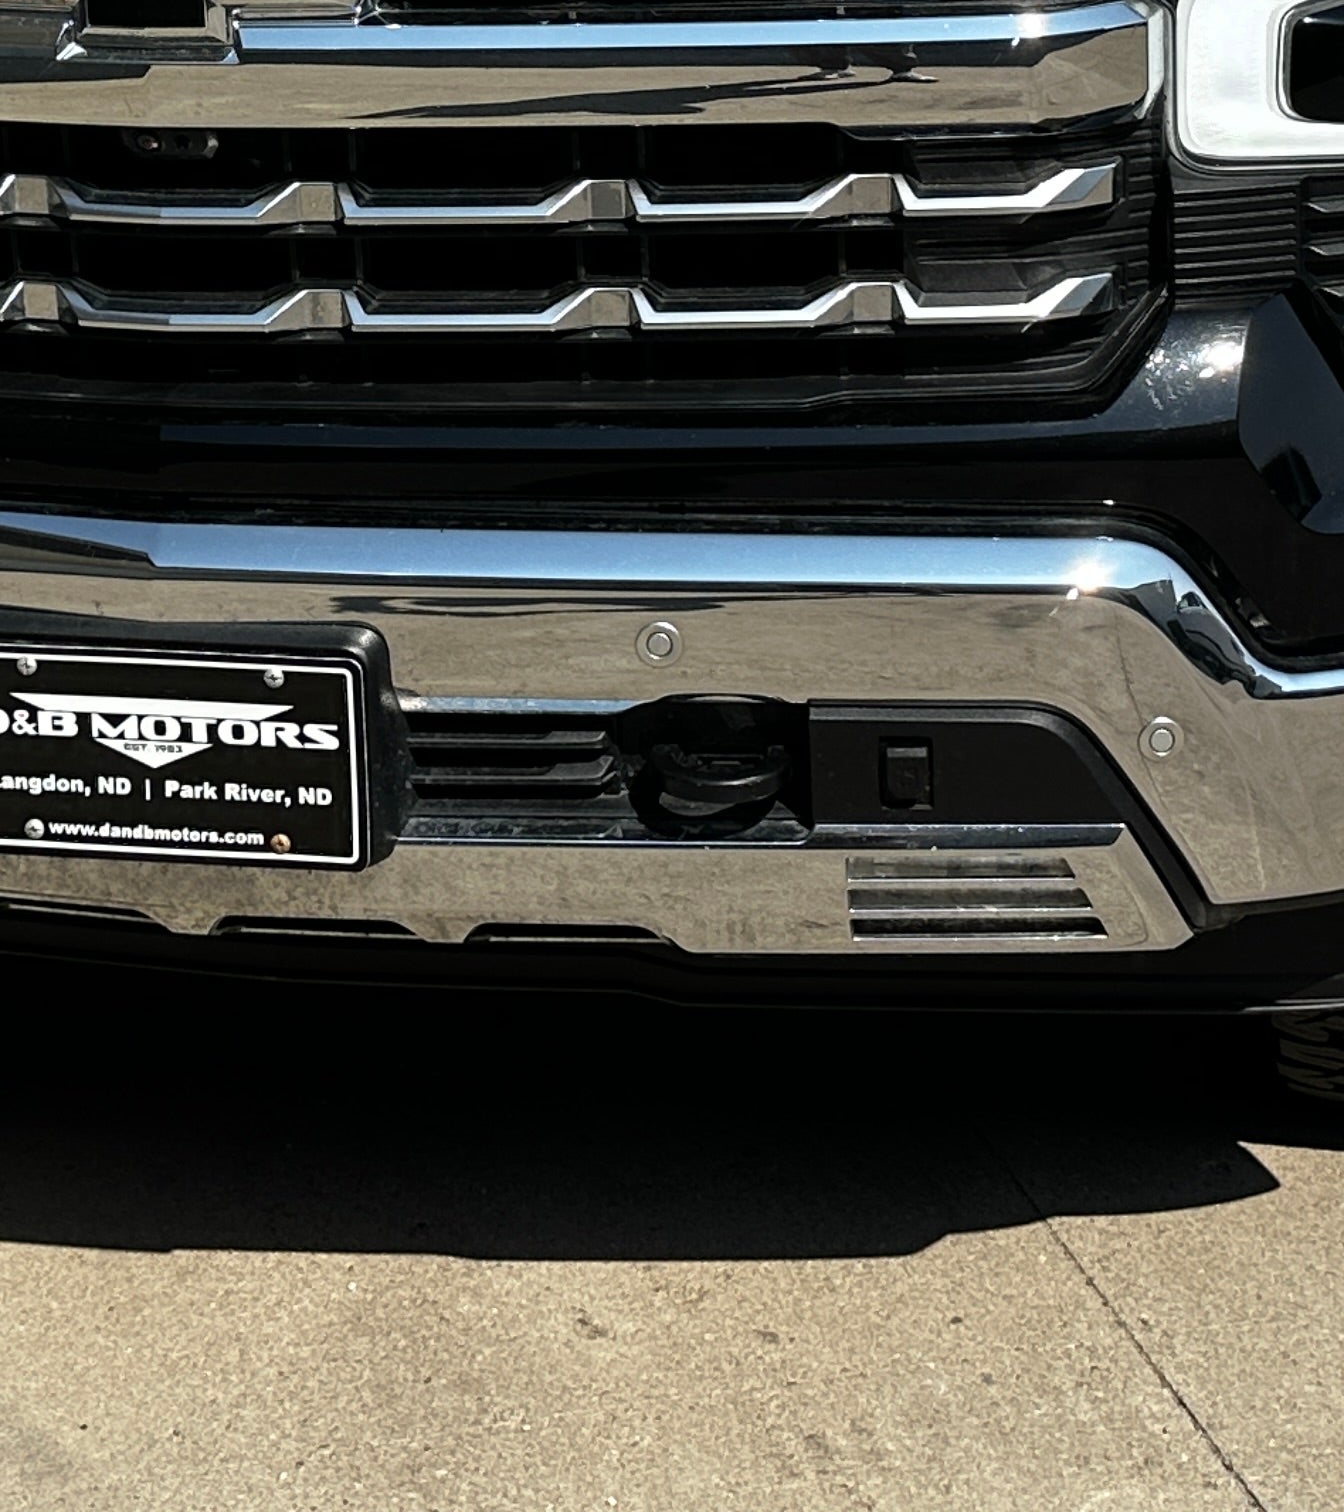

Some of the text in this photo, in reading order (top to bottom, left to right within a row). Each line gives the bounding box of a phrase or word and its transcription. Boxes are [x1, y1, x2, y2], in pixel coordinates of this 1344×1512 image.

[91, 712, 340, 751] MOTORS
[97, 775, 132, 795] ND
[164, 779, 218, 800] Park
[224, 782, 292, 808] River,
[298, 786, 333, 806] ND
[48, 821, 265, 846] www.dandbmotors.com
